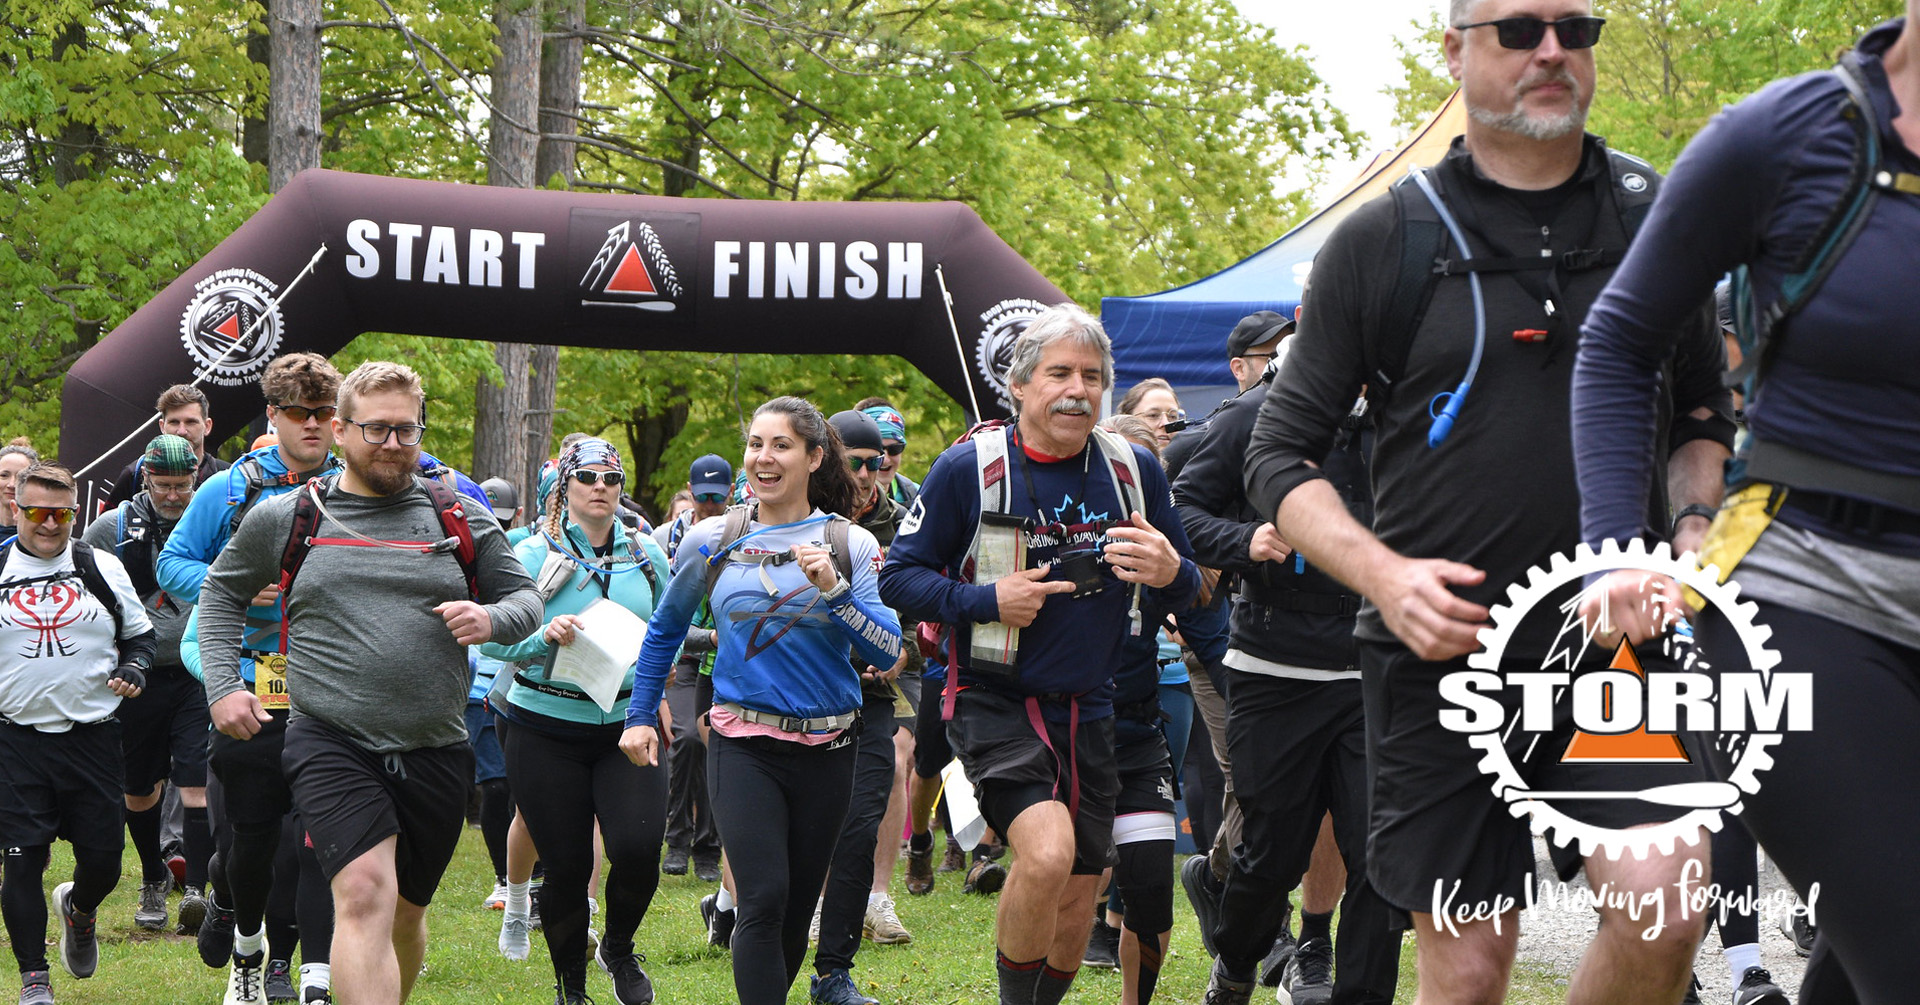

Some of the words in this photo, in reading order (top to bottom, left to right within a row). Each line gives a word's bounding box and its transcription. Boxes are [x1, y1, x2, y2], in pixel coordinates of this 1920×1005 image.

[345, 219, 546, 289] START
[713, 240, 923, 299] FINISH
[194, 275, 216, 291] Keep
[215, 267, 246, 280] Moving
[245, 268, 279, 292] Forward
[1000, 297, 1032, 310] Moving
[212, 375, 243, 386] Paddle
